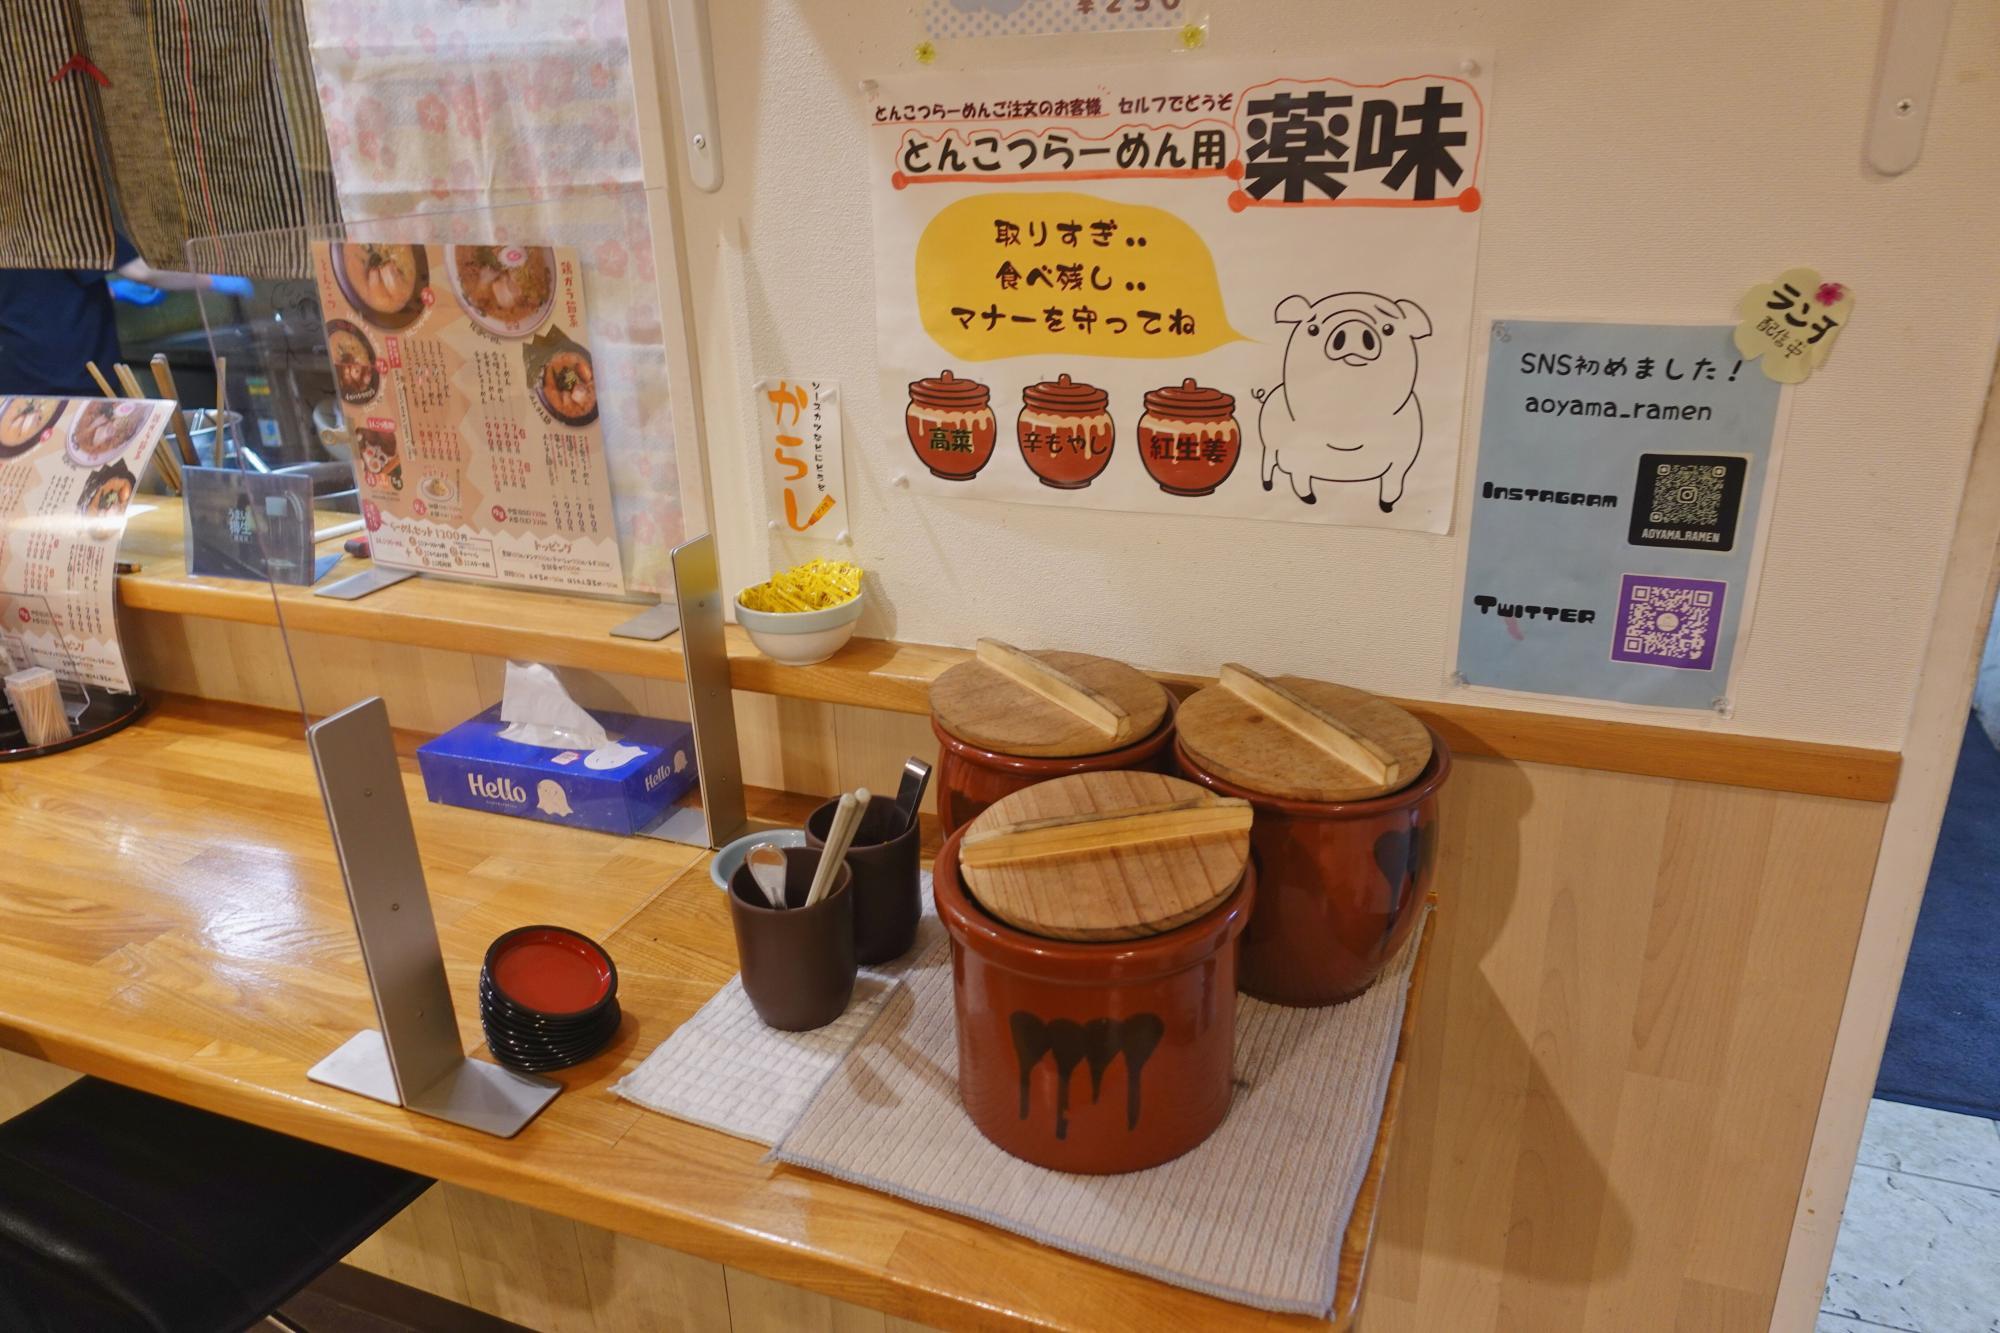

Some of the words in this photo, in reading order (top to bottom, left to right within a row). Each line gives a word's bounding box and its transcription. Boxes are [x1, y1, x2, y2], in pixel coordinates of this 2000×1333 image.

[874, 97, 1103, 121] とんこつらーめんご注文のお客様
[1118, 92, 1234, 114] セルフでどうぞ
[903, 129, 1226, 173] とんこつらーめん用
[1245, 86, 1468, 203] 薬味
[951, 303, 1196, 335] マナーを守ってね
[1525, 396, 1713, 421] aoyama_ramen
[929, 427, 973, 453] 高菜
[1023, 431, 1109, 456] 辛もやし
[1150, 437, 1229, 463] 紅生姜
[768, 379, 810, 532] からし
[1642, 528, 1721, 544] AOYAMA_RAMEN
[467, 772, 527, 804] Hello
[645, 765, 671, 793] Hello
